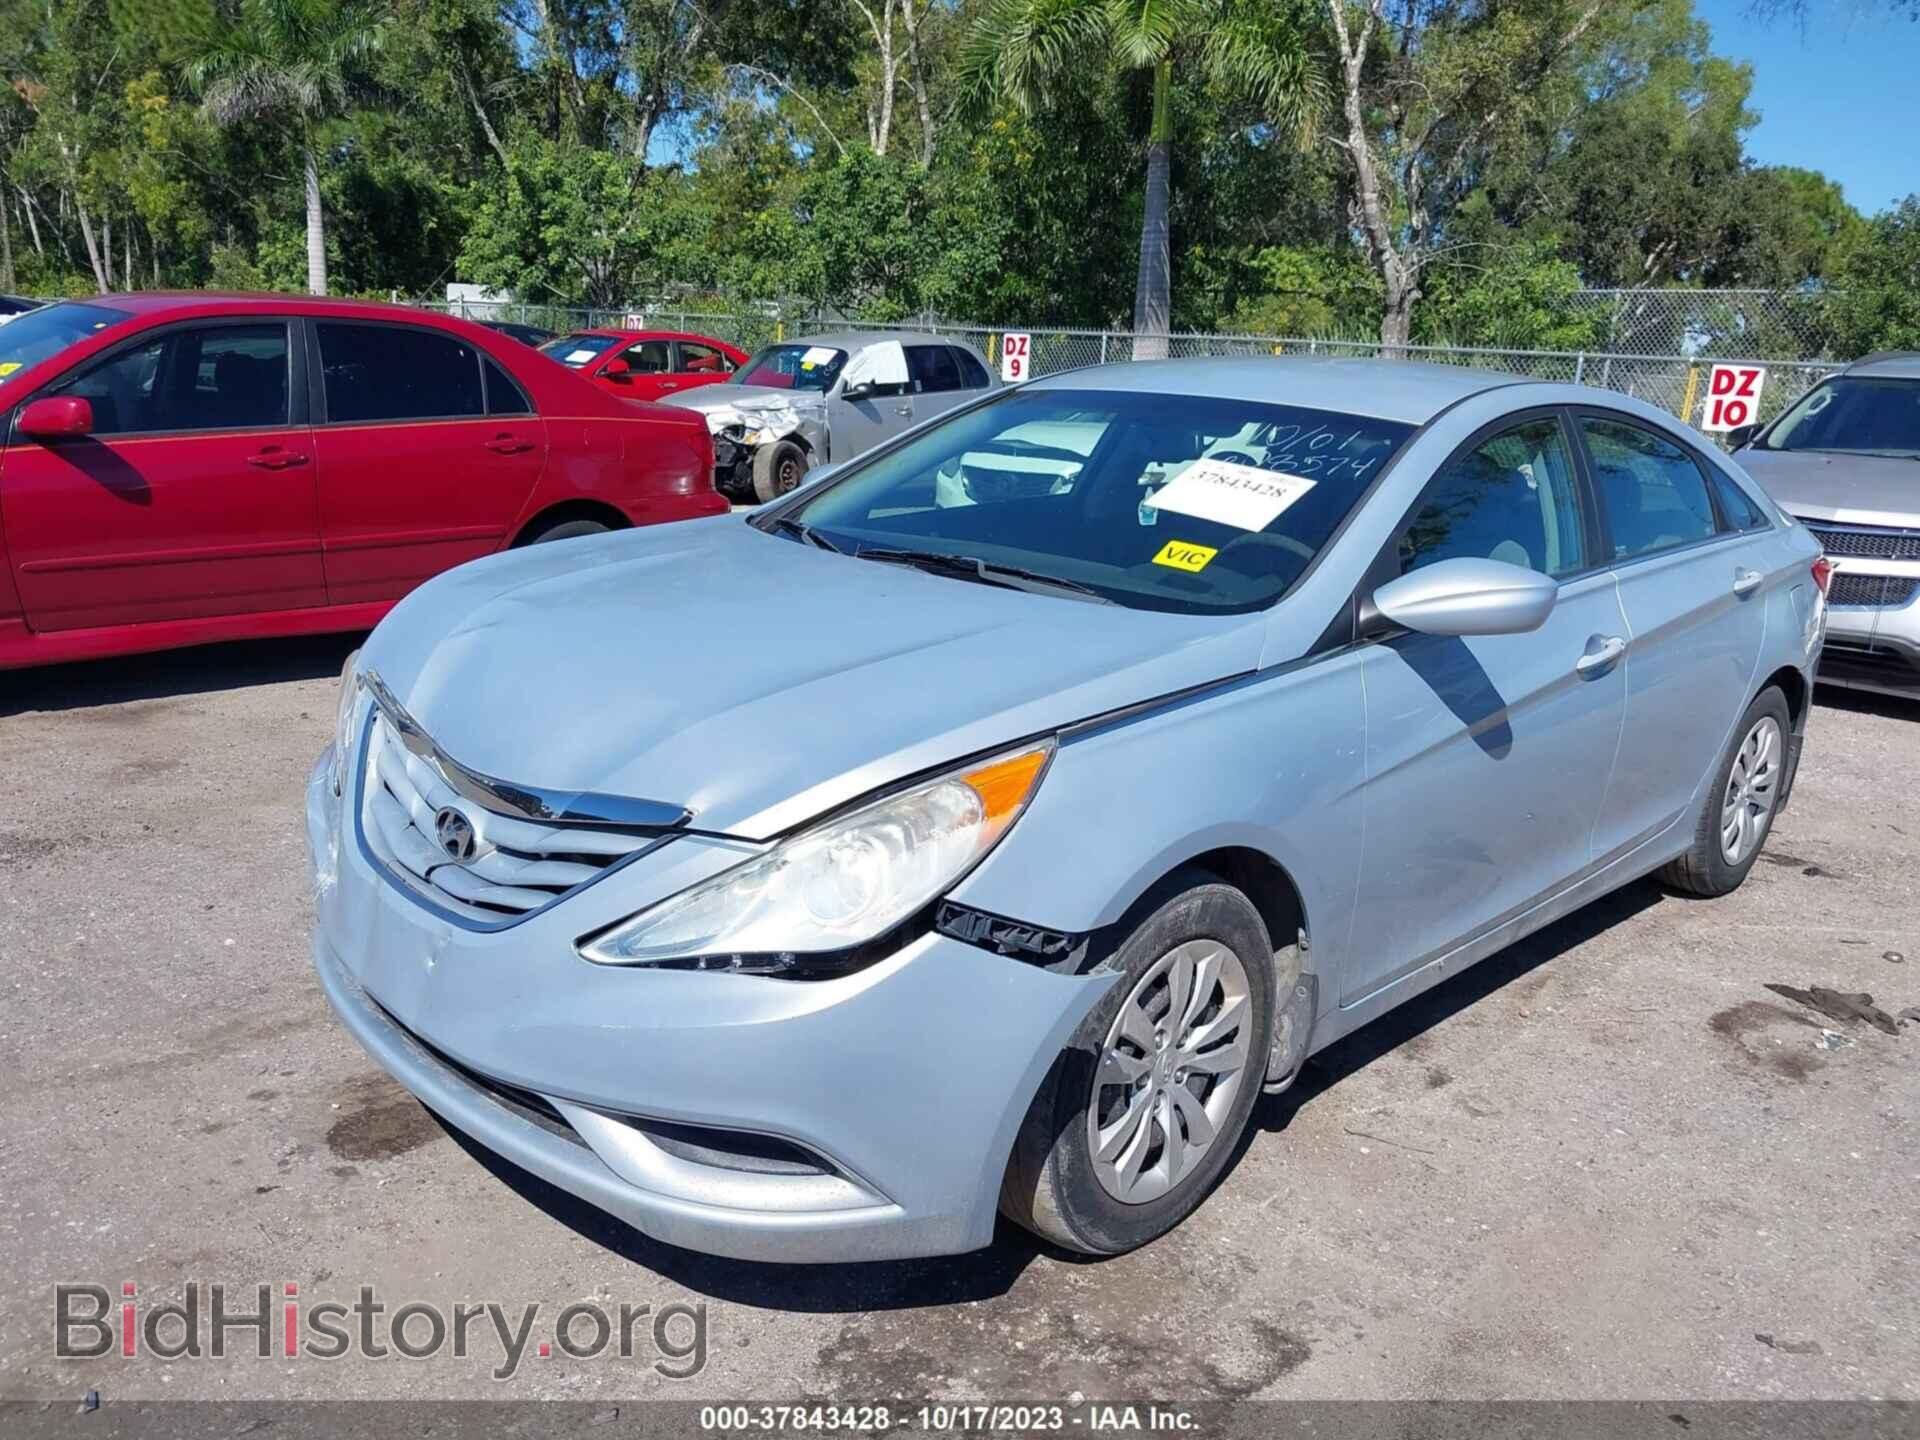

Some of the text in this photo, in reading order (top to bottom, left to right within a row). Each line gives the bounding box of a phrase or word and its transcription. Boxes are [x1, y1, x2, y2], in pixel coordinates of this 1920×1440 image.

[1005, 336, 1028, 356] DZ
[1011, 359, 1021, 377] 9
[1712, 369, 1760, 397] DZ
[1712, 399, 1748, 426] 10
[1191, 470, 1287, 498] 37843428
[1165, 546, 1206, 565] VIC
